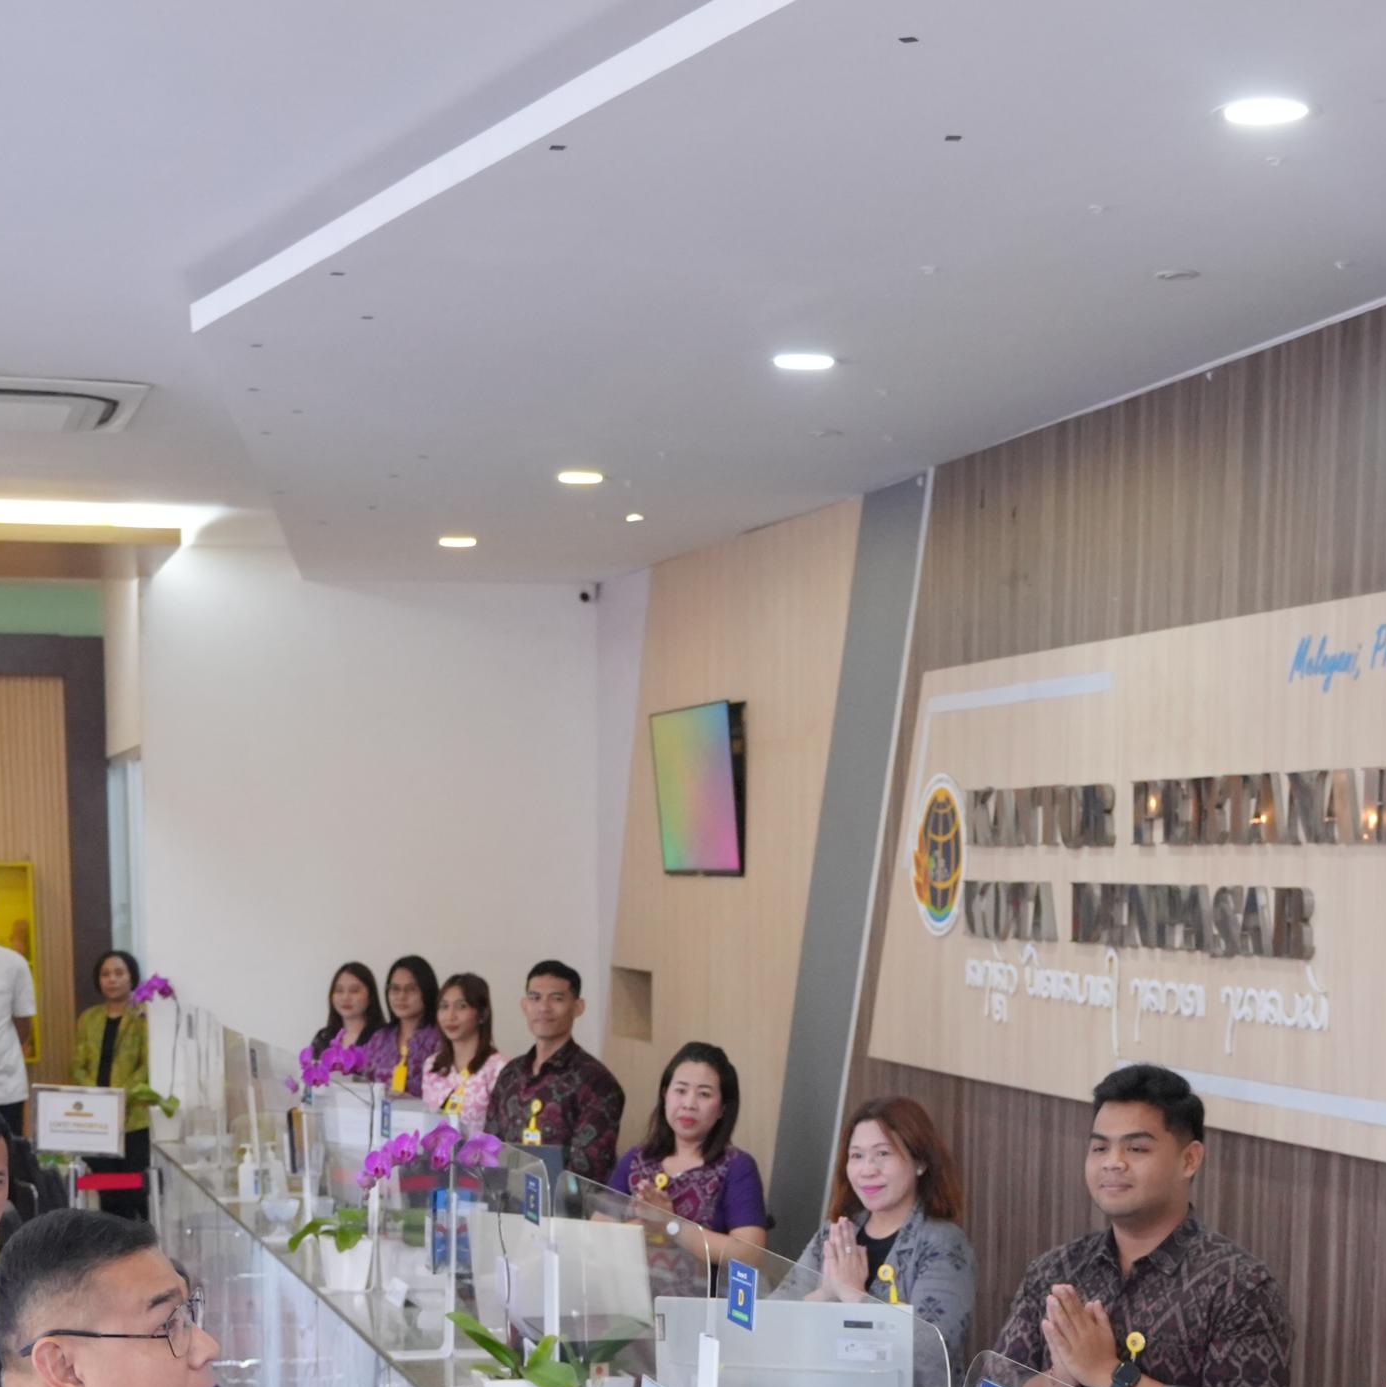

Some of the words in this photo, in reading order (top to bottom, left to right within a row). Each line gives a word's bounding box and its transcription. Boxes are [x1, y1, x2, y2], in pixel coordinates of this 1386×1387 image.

[964, 783, 1116, 849] KANTOR
[963, 881, 1059, 943] KOTA
[1070, 882, 1316, 960] DENPASAR
